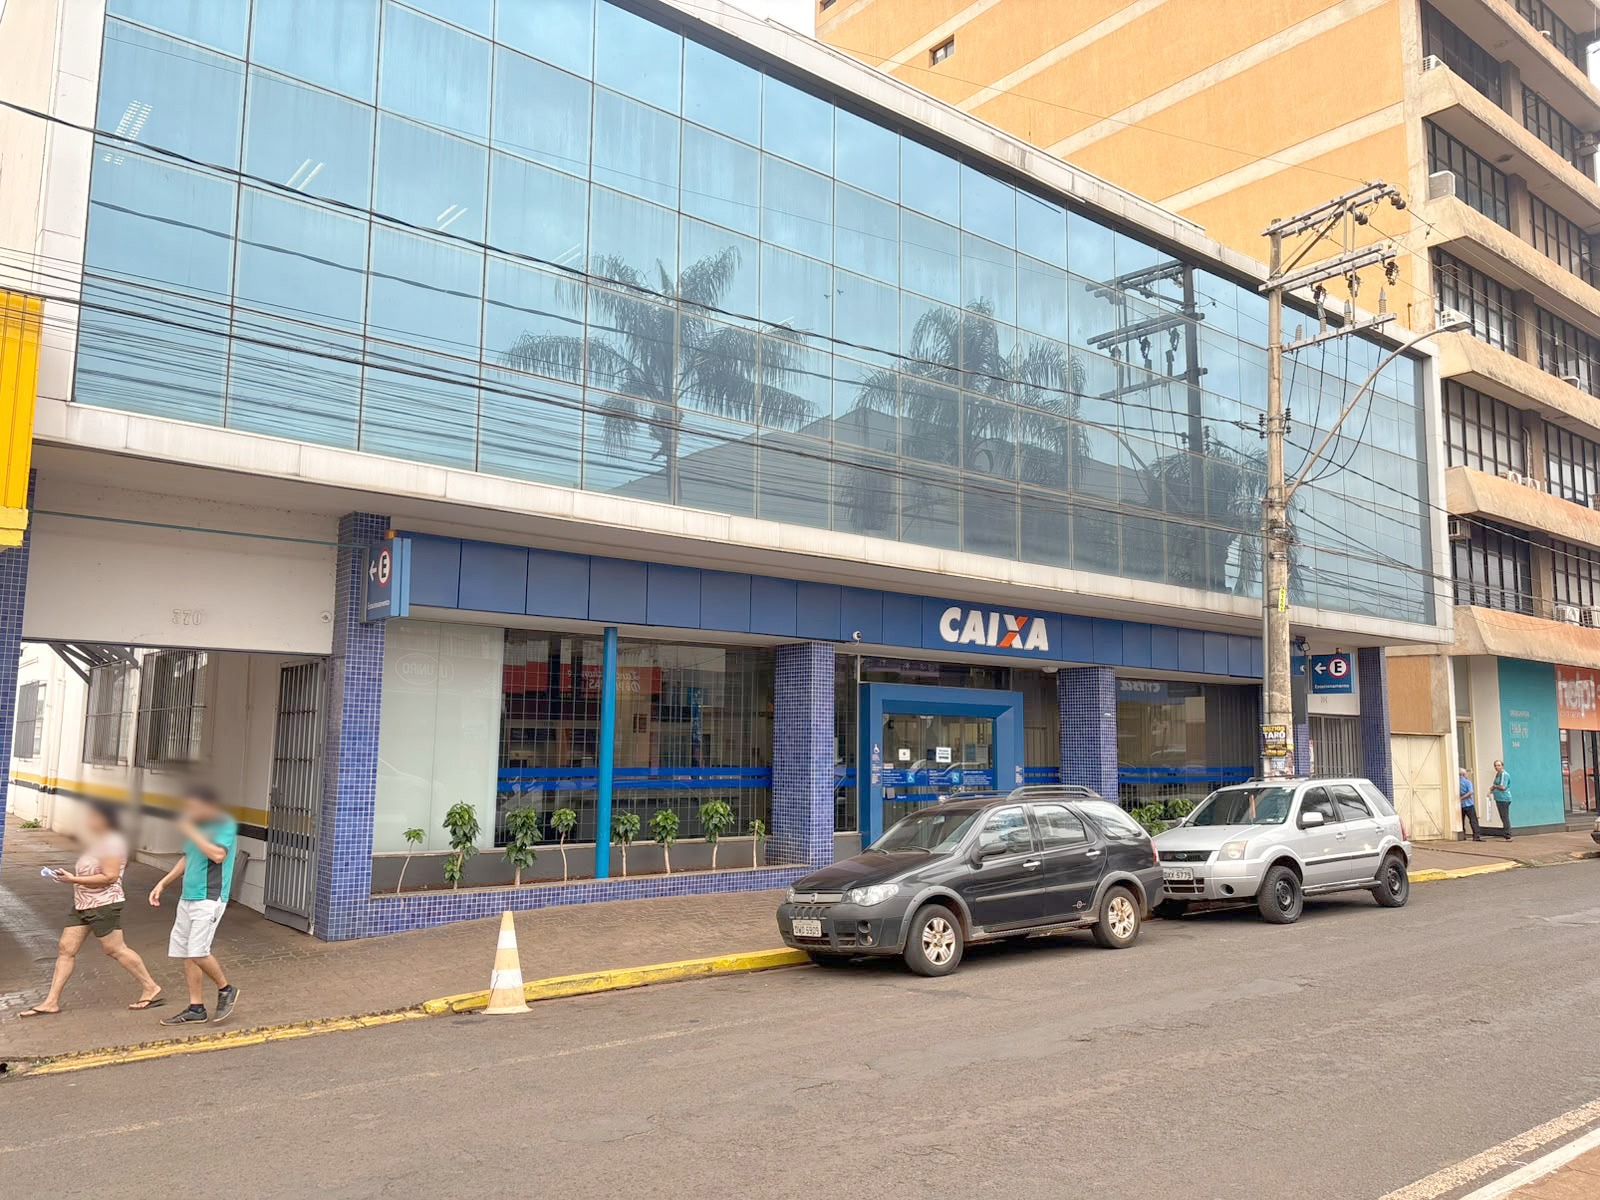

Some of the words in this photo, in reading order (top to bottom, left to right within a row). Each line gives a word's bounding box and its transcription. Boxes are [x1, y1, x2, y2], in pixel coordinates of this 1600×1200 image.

[381, 554, 387, 578] E
[171, 608, 202, 626] 370
[940, 606, 1049, 652] CAIXA
[1334, 661, 1342, 674] E
